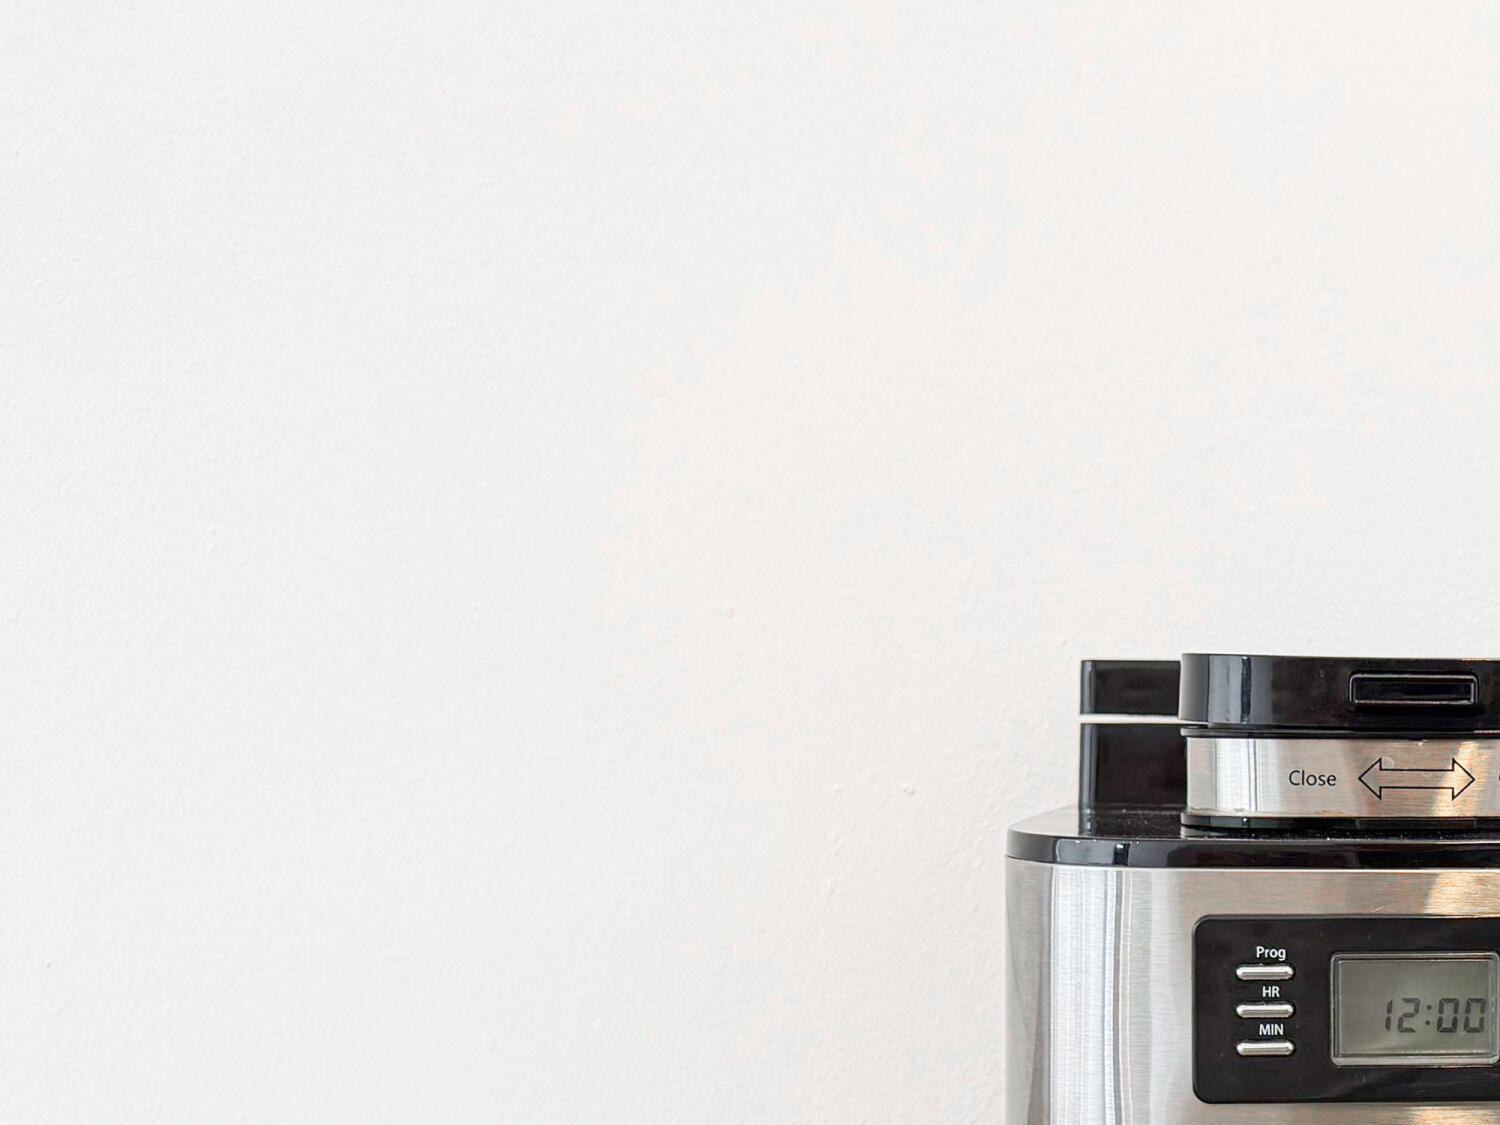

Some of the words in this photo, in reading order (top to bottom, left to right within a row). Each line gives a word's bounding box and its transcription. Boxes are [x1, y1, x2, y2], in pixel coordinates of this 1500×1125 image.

[1288, 770, 1337, 787] Close
[1256, 946, 1287, 961] Prog
[1262, 986, 1280, 998] HR
[1384, 998, 1486, 1033] 12:00
[1259, 1024, 1284, 1036] MIN
